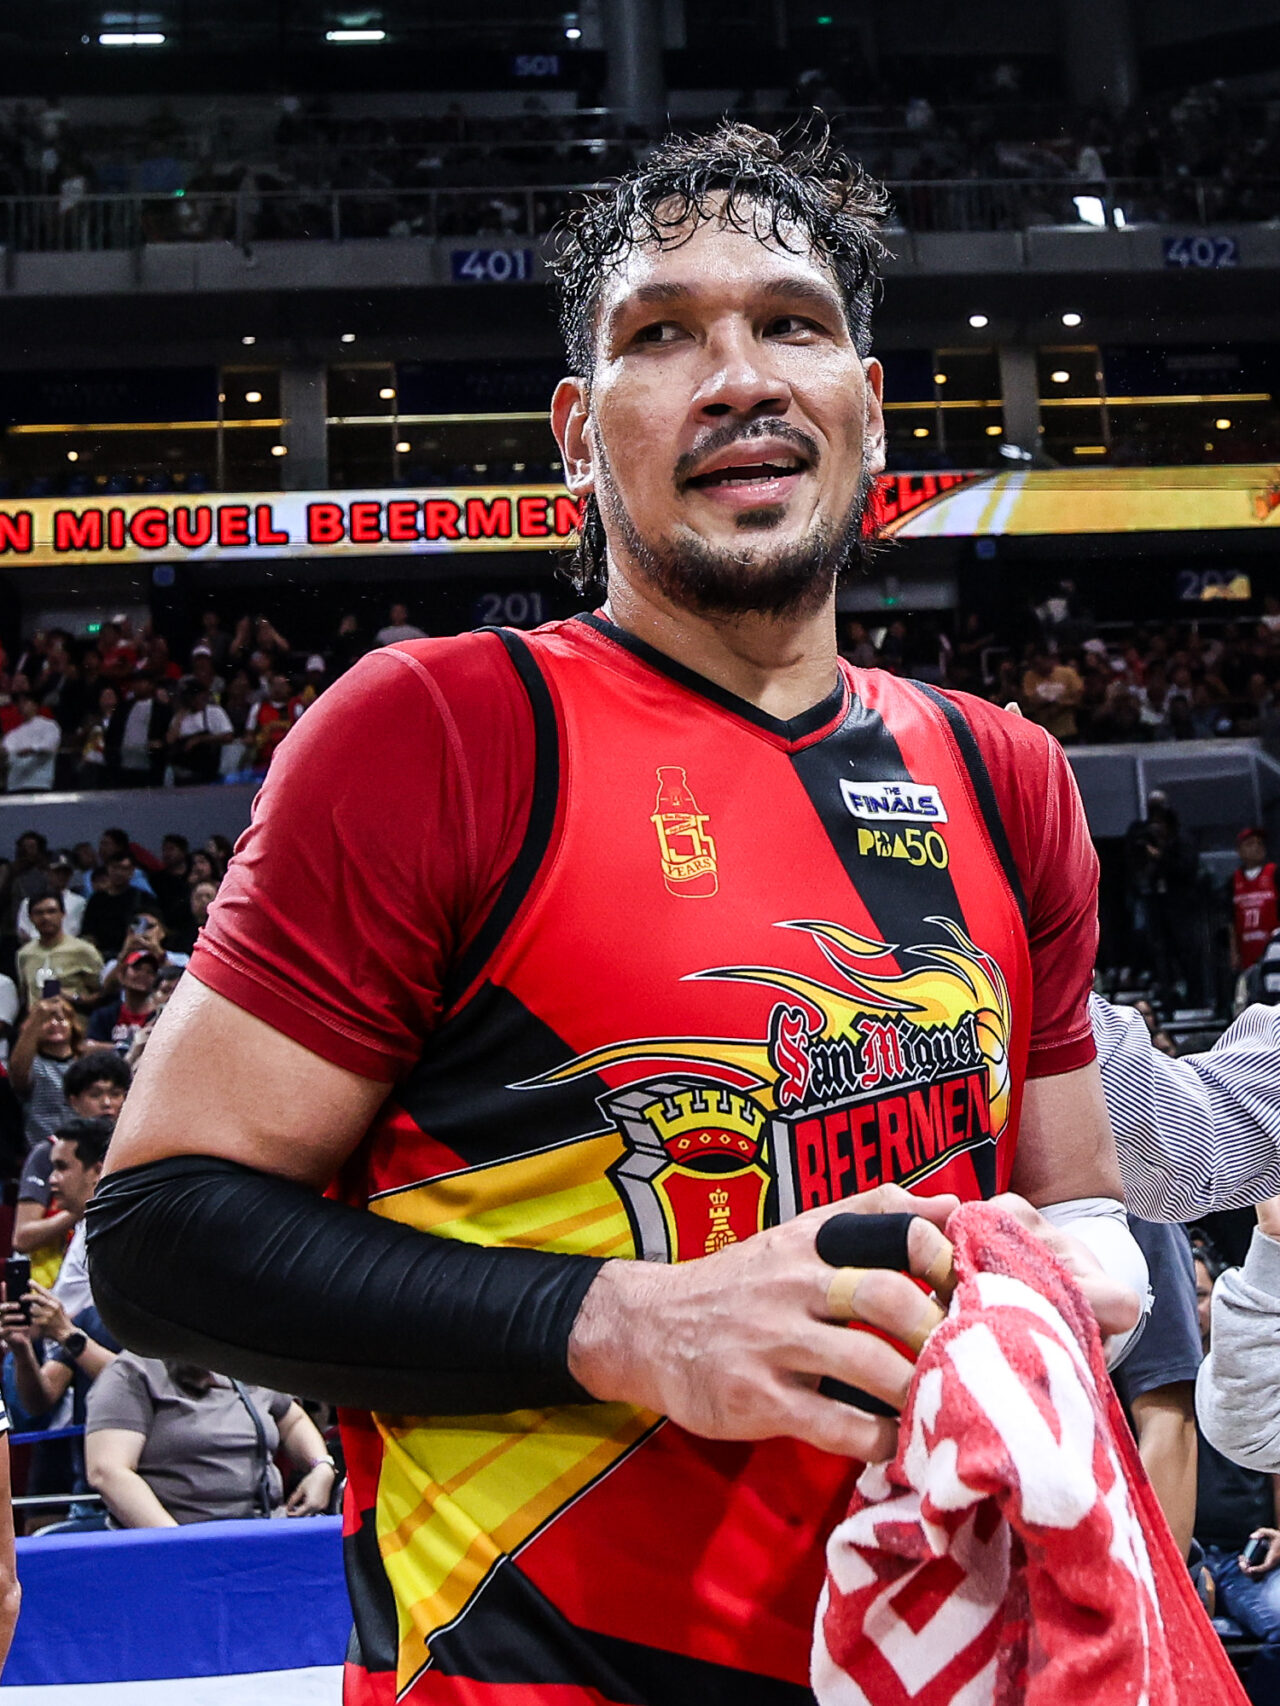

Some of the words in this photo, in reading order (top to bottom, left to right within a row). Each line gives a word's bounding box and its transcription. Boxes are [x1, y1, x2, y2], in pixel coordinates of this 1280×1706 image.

[461, 251, 527, 280] 401
[1168, 237, 1236, 267] 402
[54, 504, 289, 551] MIGUEL
[307, 496, 585, 544] BEERMEN
[1181, 570, 1243, 599] 20
[482, 592, 543, 623] 201
[848, 791, 938, 815] FINALS
[883, 787, 901, 796] THE
[667, 858, 713, 877] YEARS
[775, 1004, 858, 1107] San
[858, 1011, 984, 1090] Miguel
[795, 1071, 990, 1212] BEERMEN
